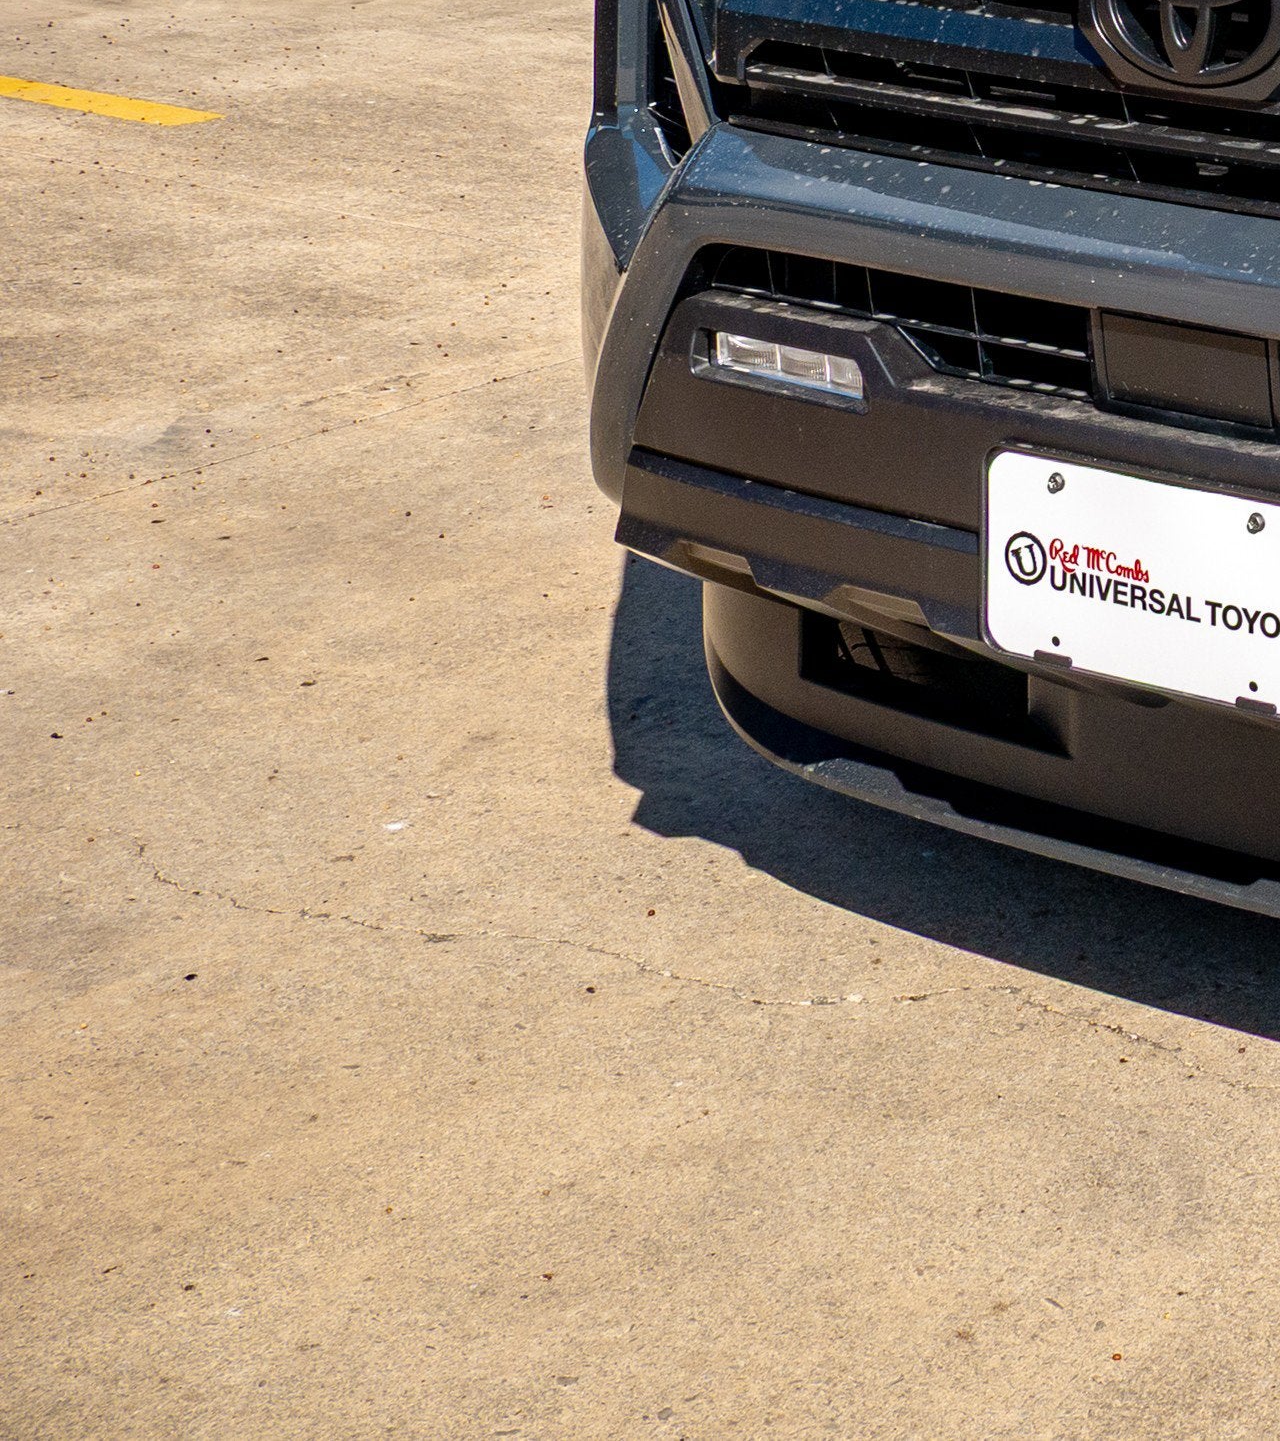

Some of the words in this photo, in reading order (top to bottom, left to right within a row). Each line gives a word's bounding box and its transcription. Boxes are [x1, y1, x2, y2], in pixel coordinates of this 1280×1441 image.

[1049, 537, 1080, 574] Red
[1082, 545, 1150, 584] McCombs
[1050, 565, 1202, 624] UNIVERSAL
